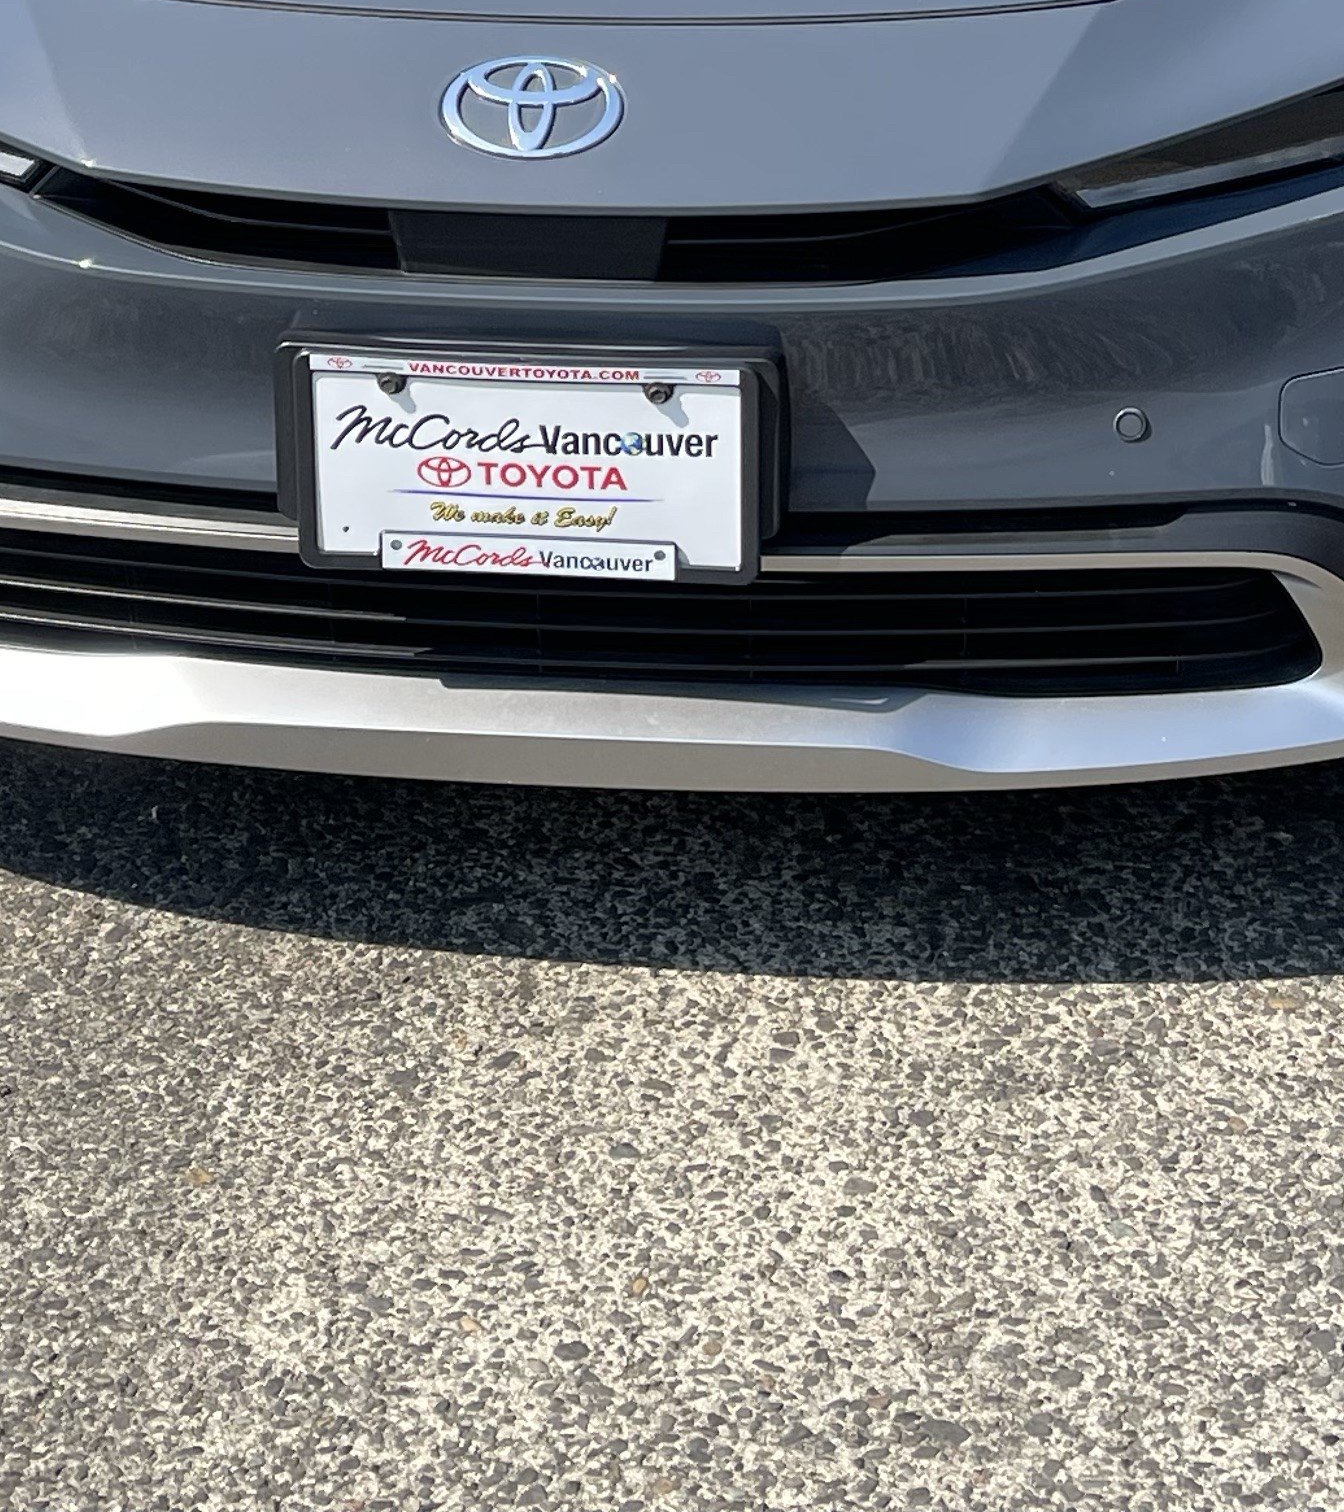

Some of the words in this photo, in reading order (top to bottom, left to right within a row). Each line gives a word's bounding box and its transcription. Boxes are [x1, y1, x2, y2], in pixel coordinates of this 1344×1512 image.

[408, 362, 640, 381] VANCOUVERTOYOTA.COM
[477, 461, 628, 491] TOYOTA
[430, 501, 465, 522] We
[471, 506, 525, 525] make
[530, 508, 549, 526] it
[554, 506, 618, 532] Easy!
